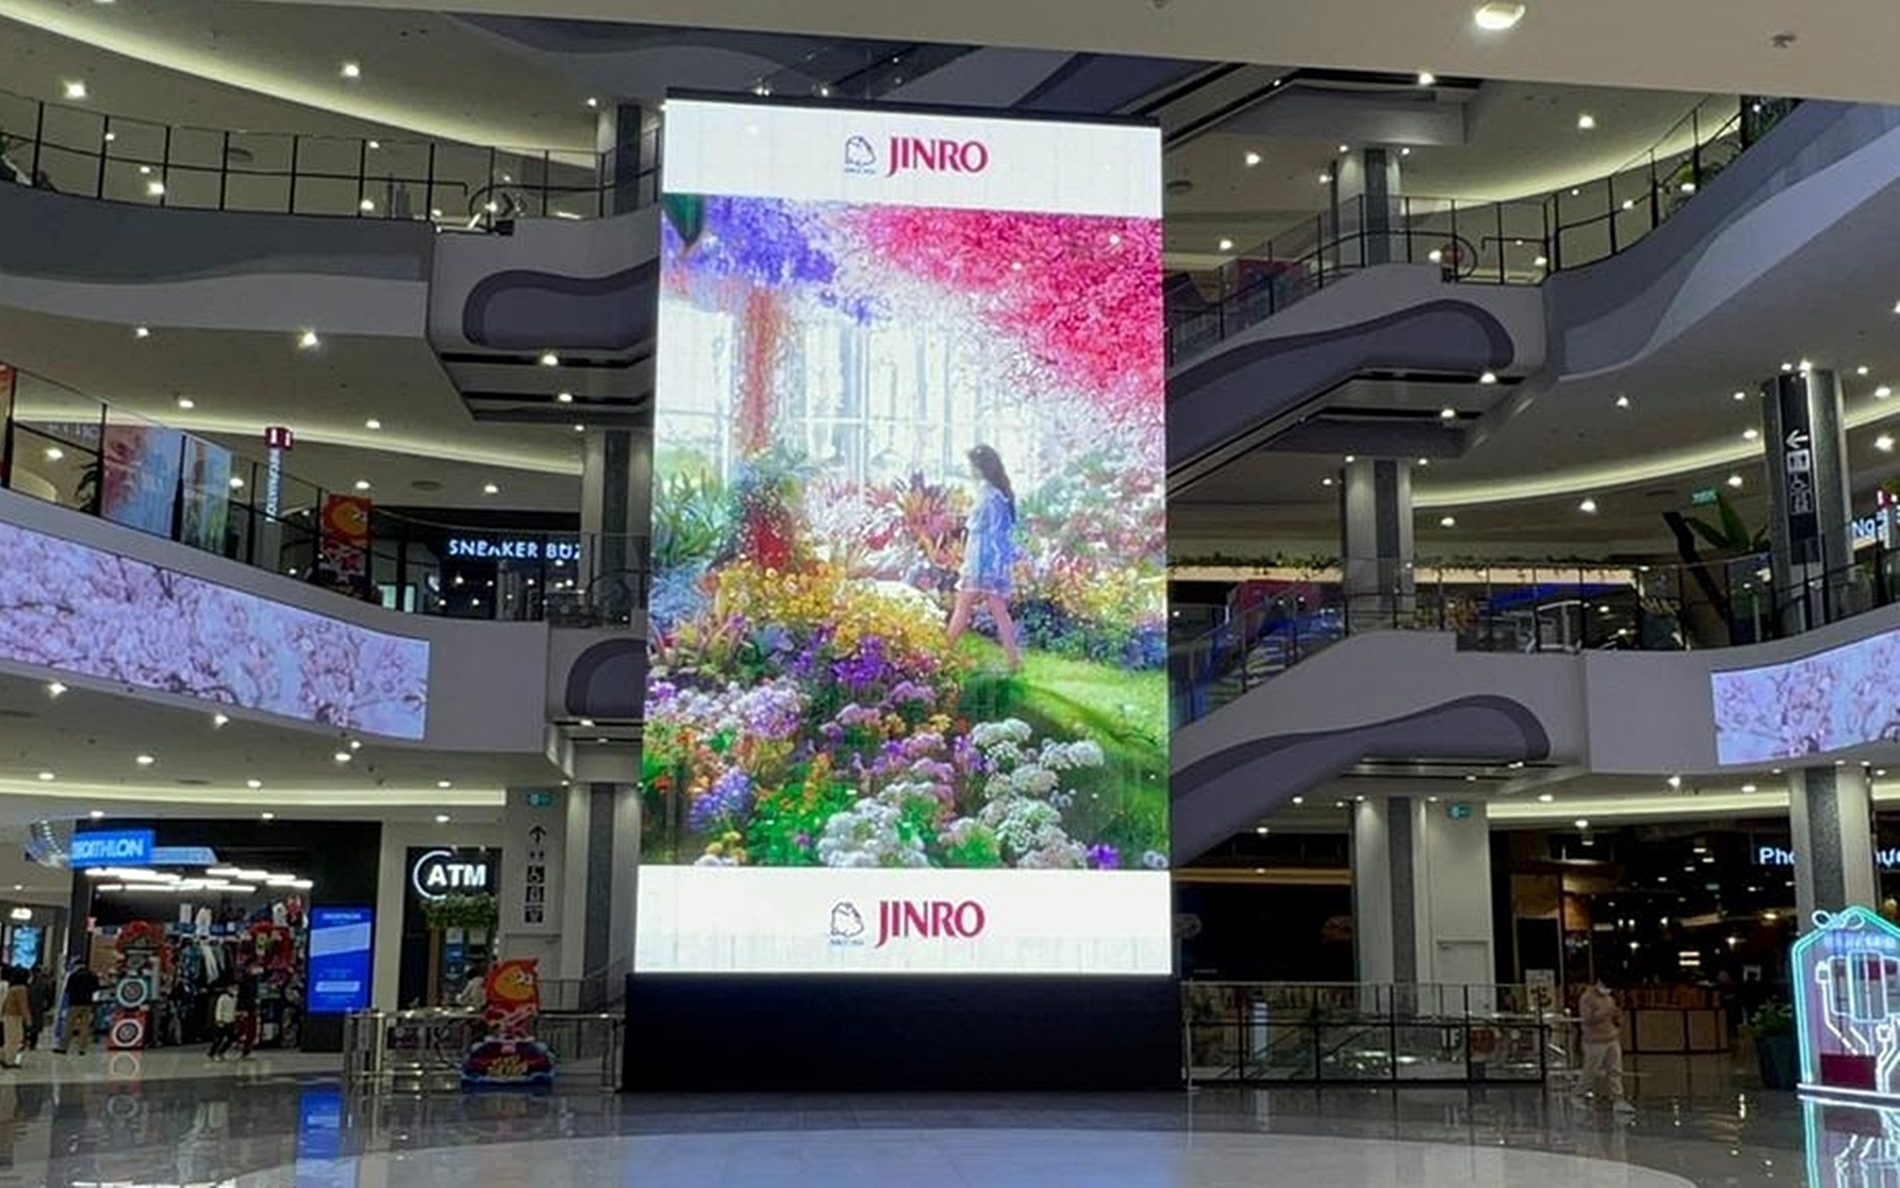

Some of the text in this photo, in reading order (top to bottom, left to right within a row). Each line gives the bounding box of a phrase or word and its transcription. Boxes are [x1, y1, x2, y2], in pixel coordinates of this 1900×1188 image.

[885, 136, 989, 178] JINRO
[449, 539, 538, 558] SNEAKER
[427, 864, 487, 887] ATM
[875, 900, 985, 949] JINRO
